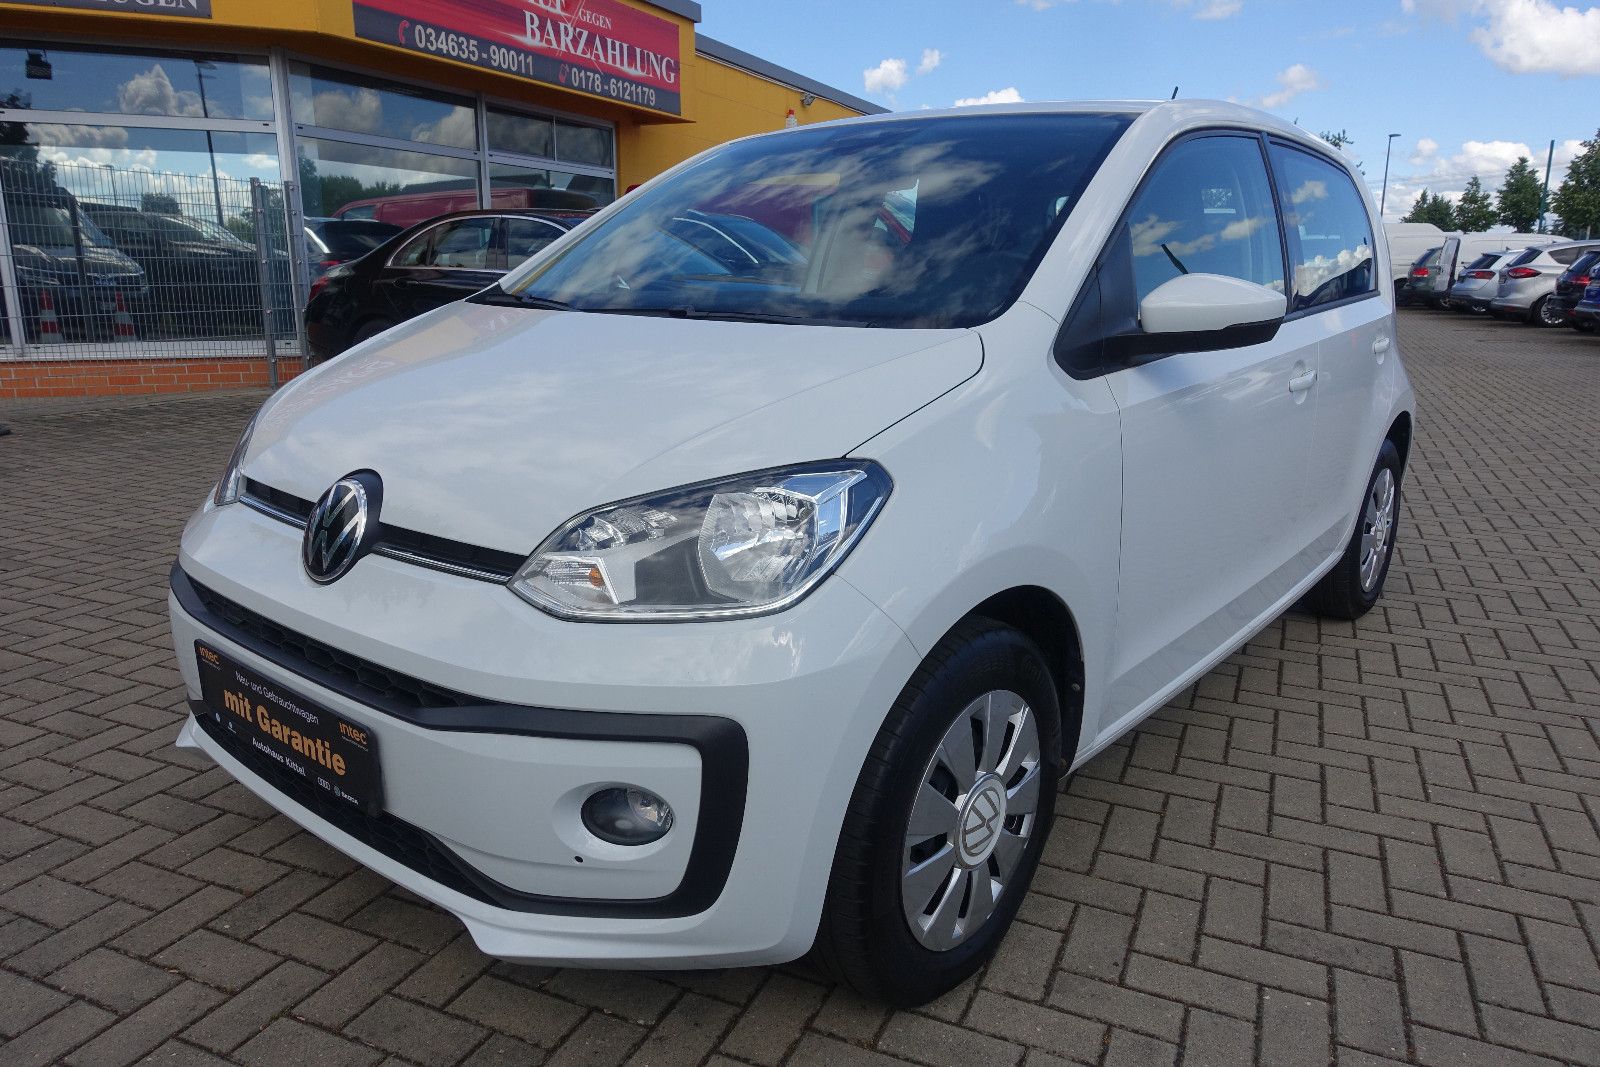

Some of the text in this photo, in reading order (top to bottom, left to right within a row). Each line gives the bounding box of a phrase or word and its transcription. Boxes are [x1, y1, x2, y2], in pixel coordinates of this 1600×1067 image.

[579, 9, 612, 30] GEGEN
[523, 10, 676, 84] BARZAHLUNG
[250, 681, 263, 695] und
[262, 686, 319, 725] Gebrauchtwagen
[223, 689, 346, 776] mit Garantie
[339, 721, 368, 745] intec
[252, 736, 306, 777] Autohaus Kittel
